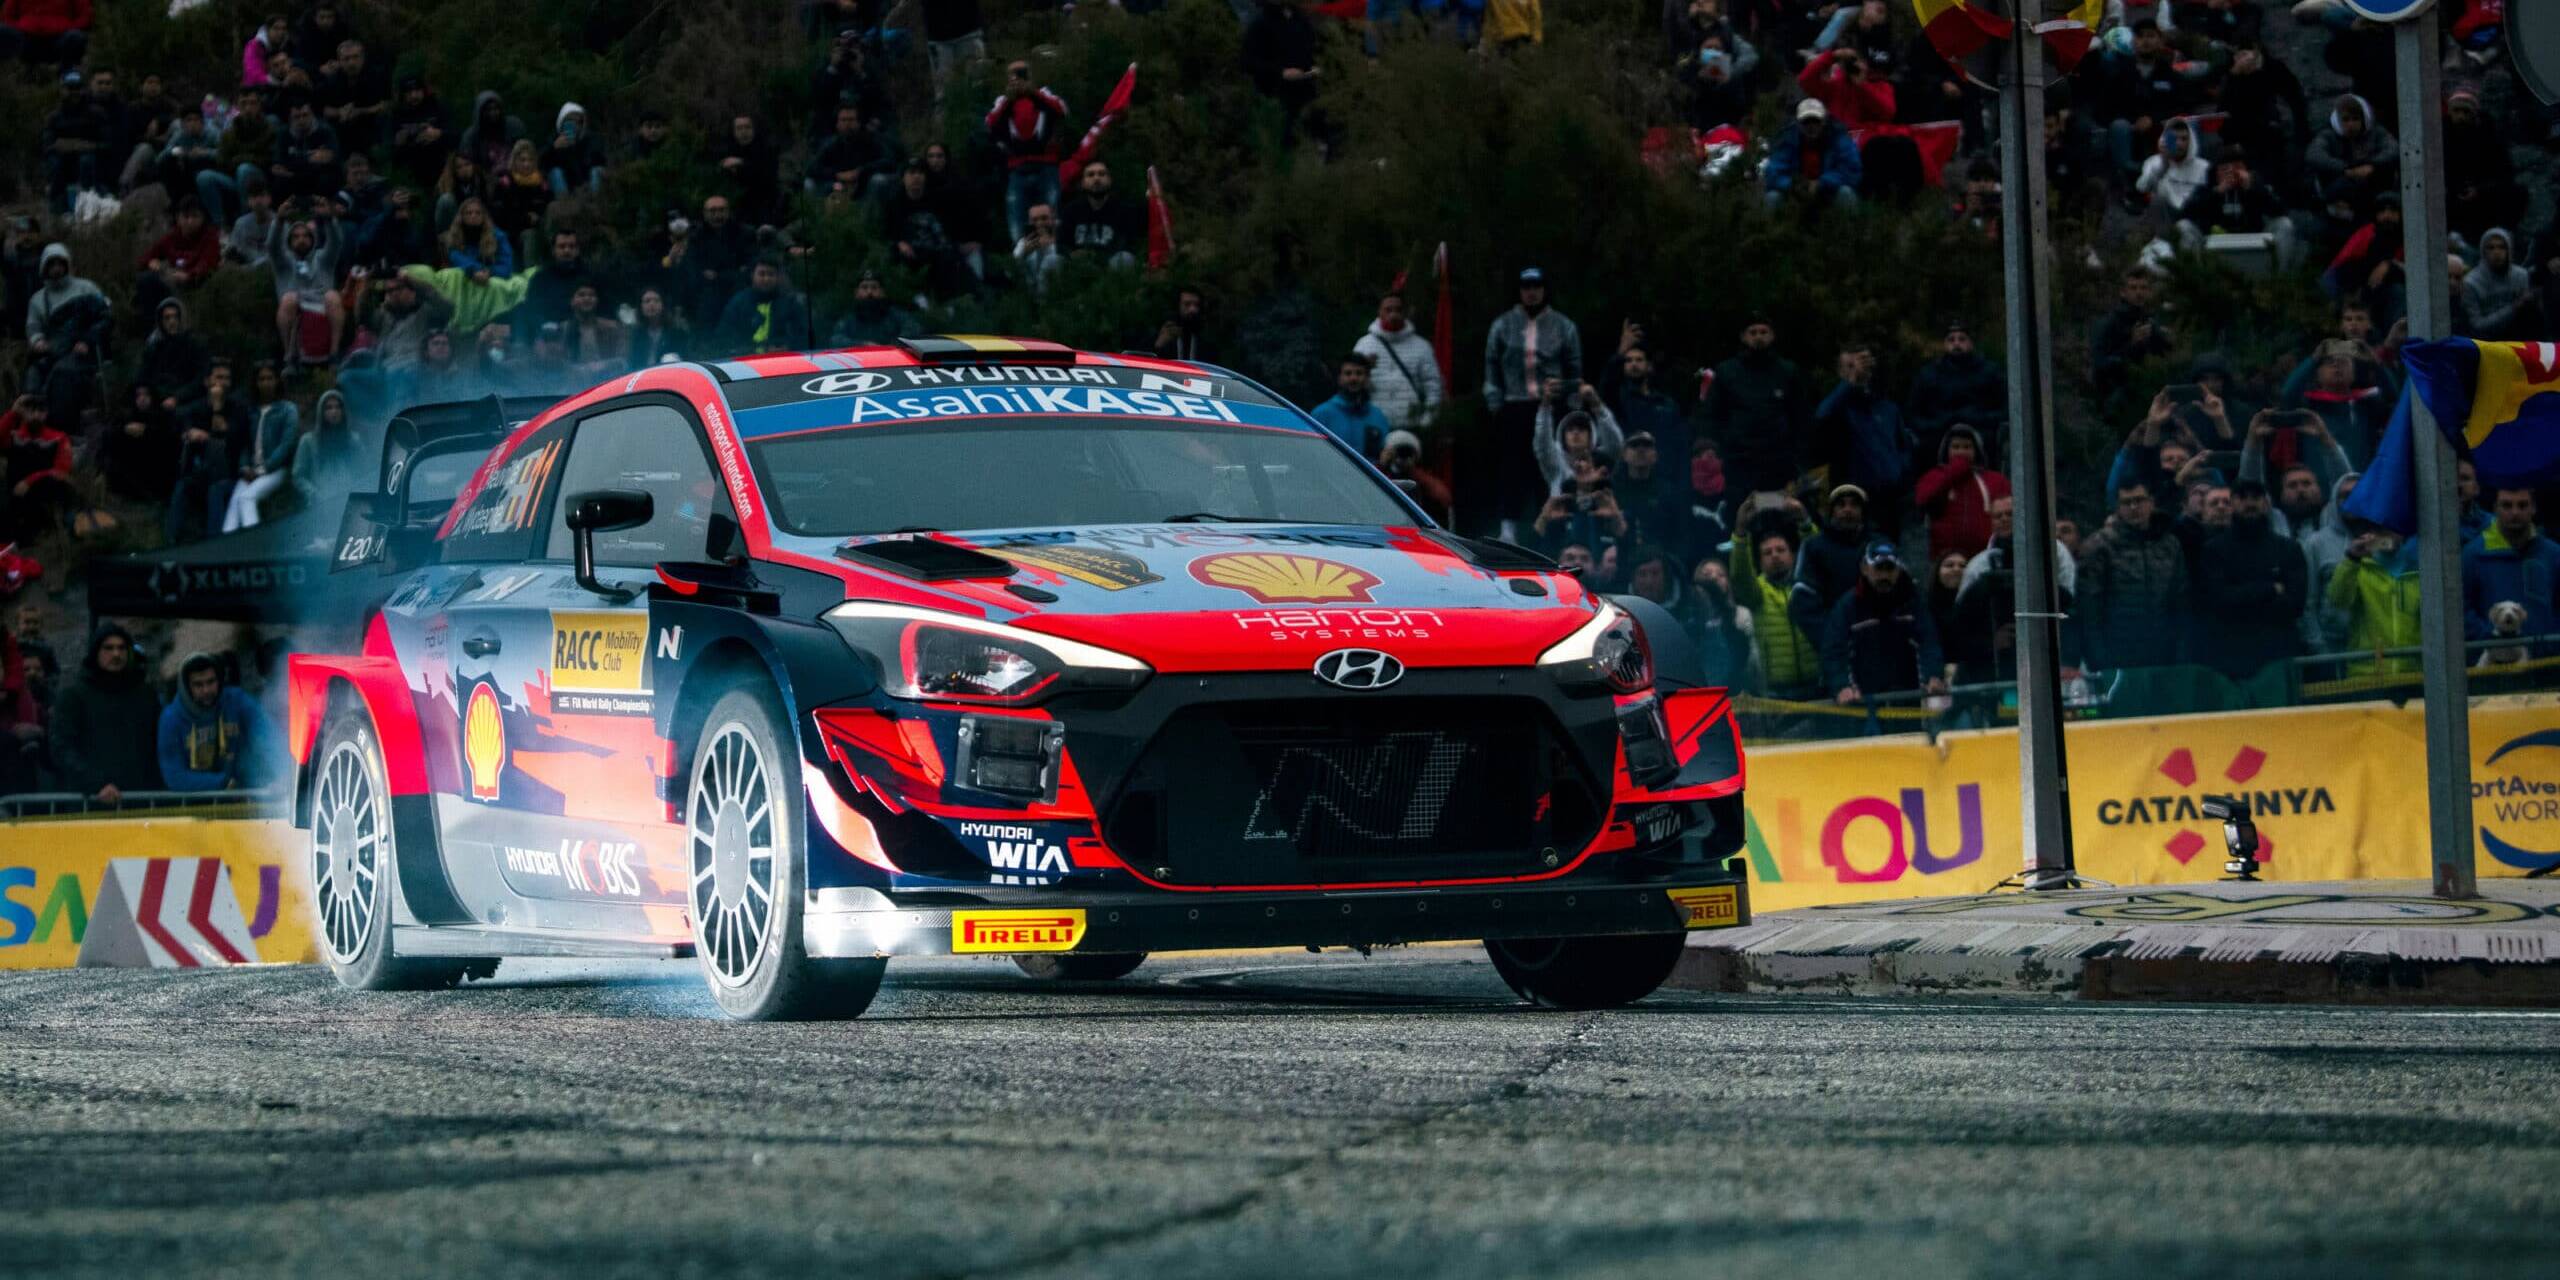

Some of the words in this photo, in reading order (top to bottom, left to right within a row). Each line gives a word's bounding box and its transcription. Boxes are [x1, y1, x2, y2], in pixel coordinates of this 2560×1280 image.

[903, 366, 1117, 386] HYUNDAI
[703, 402, 753, 521] motorsport.hyundai.com
[193, 564, 307, 589] XLMOTO
[1270, 628, 1430, 641] SYSTEMS
[555, 630, 602, 672] RACC
[605, 631, 642, 655] Mobility
[603, 653, 622, 672] Club
[572, 697, 582, 709] FIA
[582, 697, 597, 710] World
[598, 697, 611, 713] Rally
[613, 698, 650, 714] Championship
[2471, 775, 2560, 799] ortAve
[960, 822, 1033, 840] HYUNDAI
[505, 846, 562, 877] HYUNDAI
[559, 837, 641, 897] MOBIS
[963, 917, 1075, 944] PIRELLI
